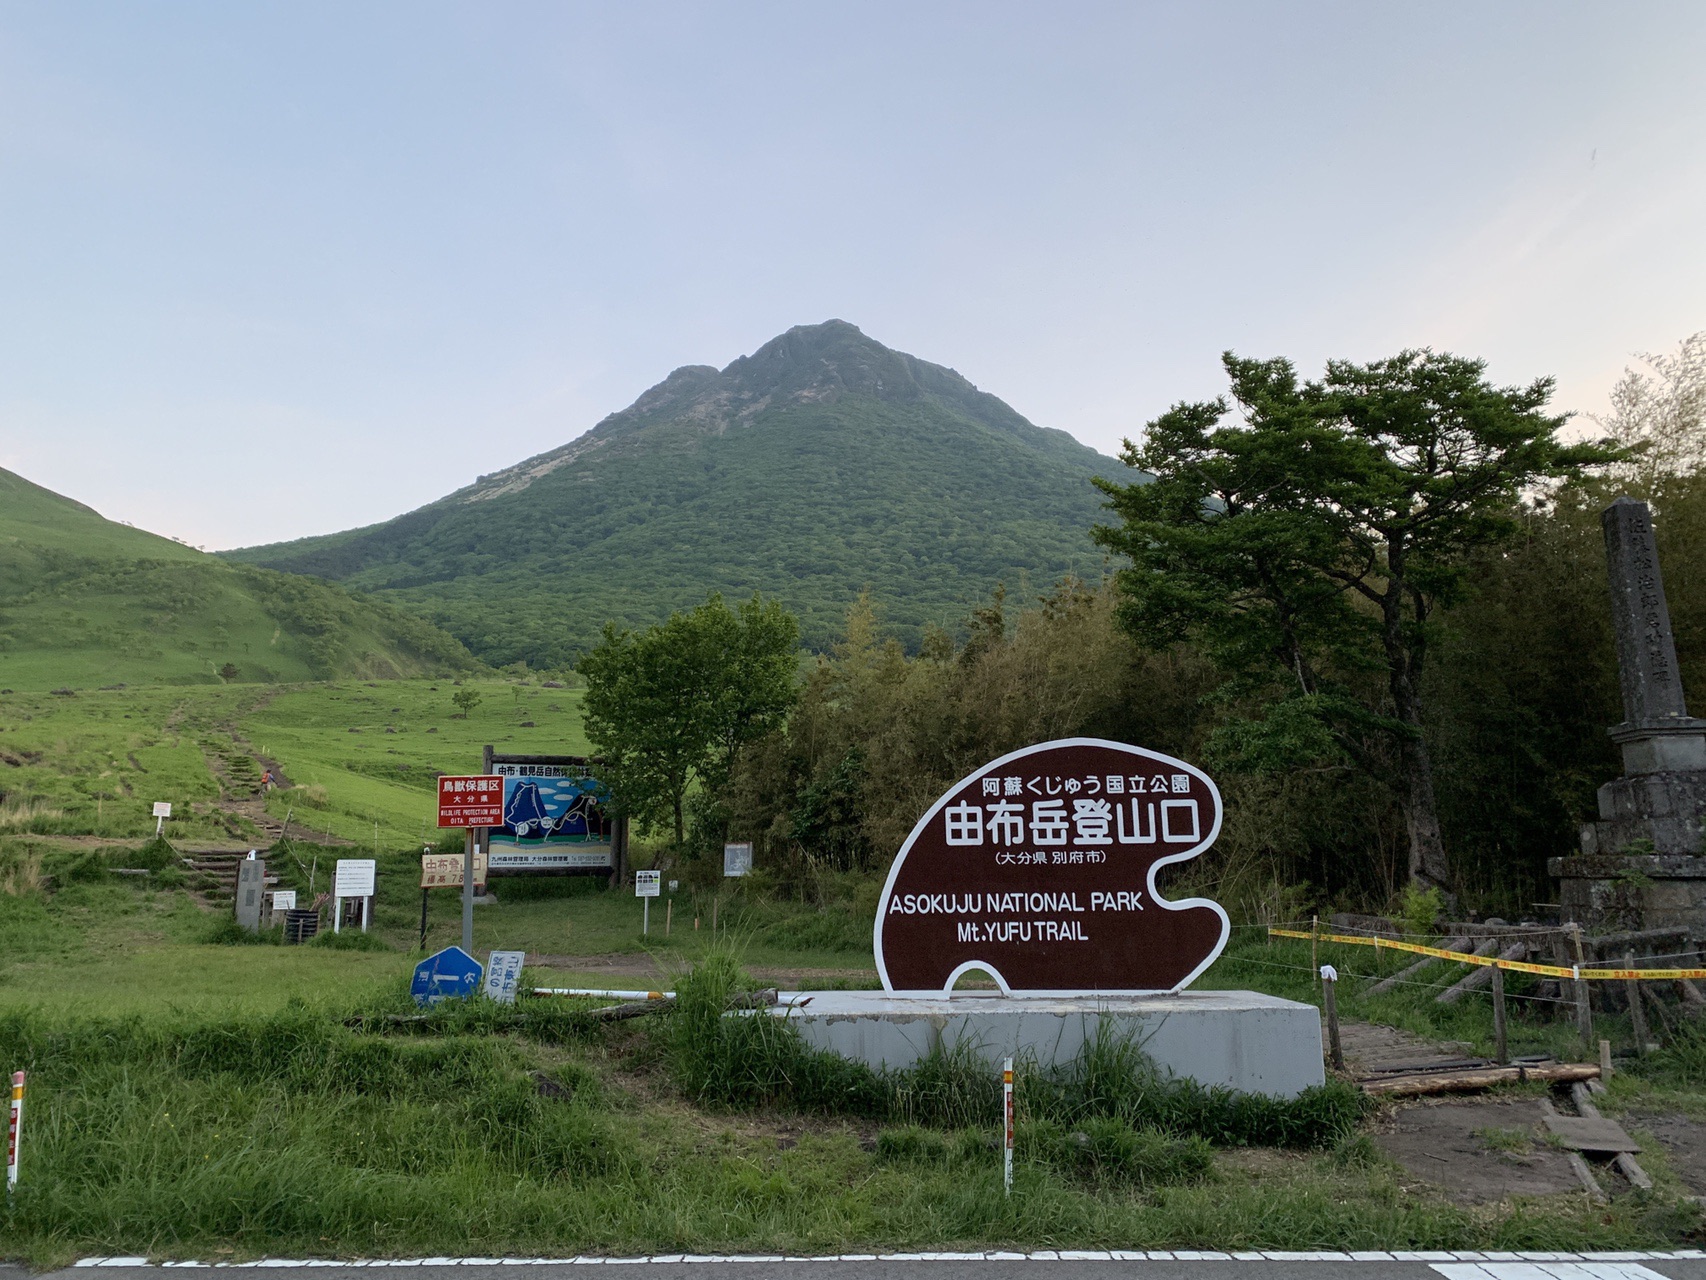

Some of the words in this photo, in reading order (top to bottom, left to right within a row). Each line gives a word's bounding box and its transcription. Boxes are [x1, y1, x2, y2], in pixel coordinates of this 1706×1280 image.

[442, 780, 500, 792] 鳥獣保護区
[982, 774, 1191, 797] 阿蘇くじゅう国立公園
[453, 794, 488, 803] 大分県
[468, 816, 494, 824] PREFECTURE
[945, 797, 1201, 846] 由布岳登山口
[995, 851, 1048, 865] (大分県
[1051, 850, 1107, 865] 別府市)
[889, 894, 982, 915] ASOKUJU
[986, 892, 1085, 913] NATIONAL
[1091, 891, 1144, 912] PARK
[1033, 921, 1088, 942] TRAIL
